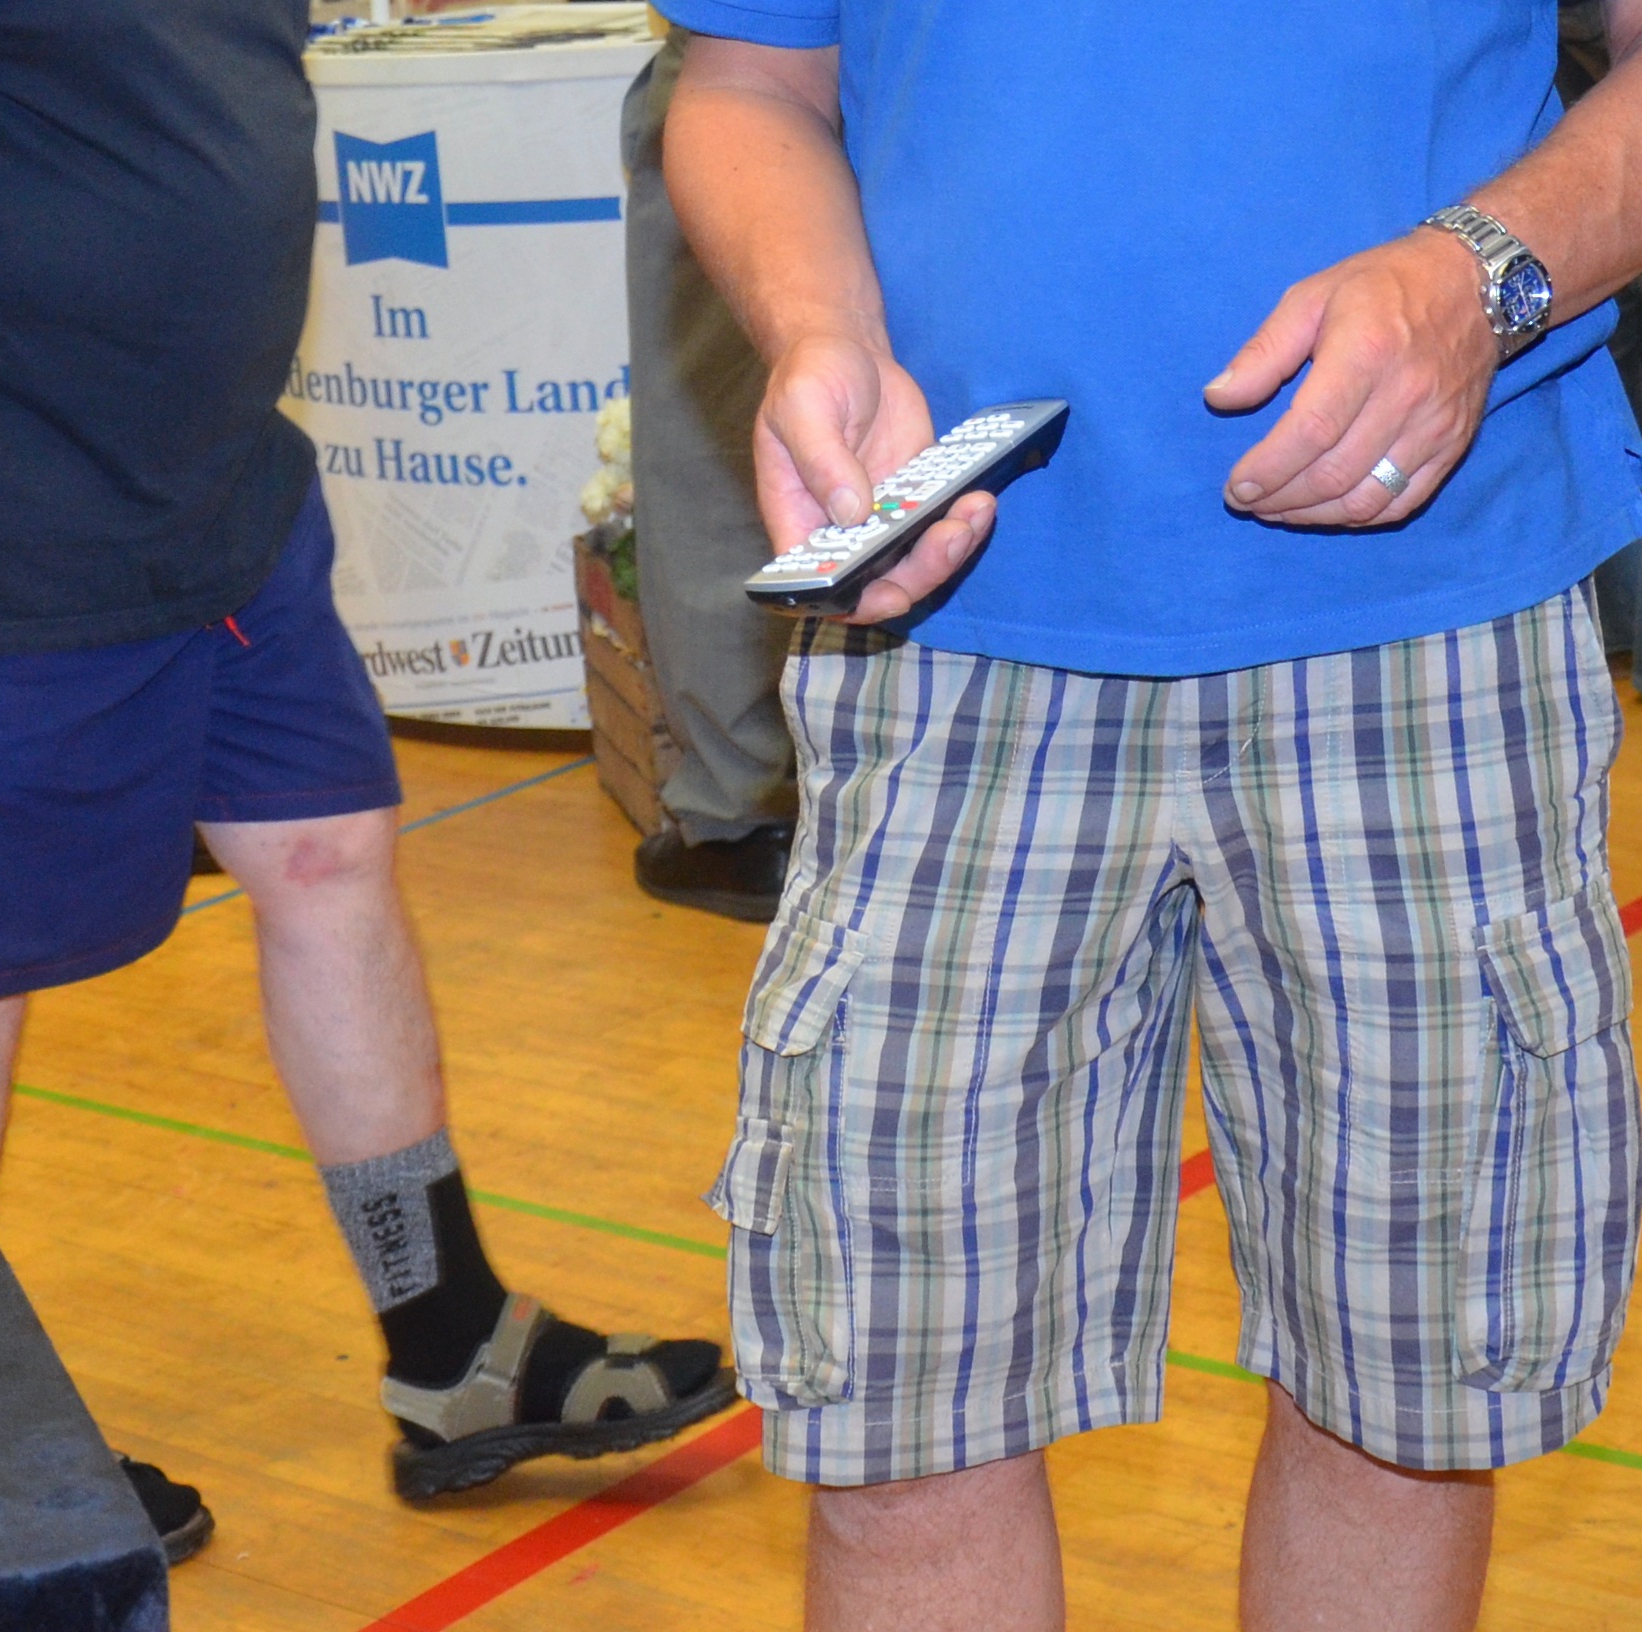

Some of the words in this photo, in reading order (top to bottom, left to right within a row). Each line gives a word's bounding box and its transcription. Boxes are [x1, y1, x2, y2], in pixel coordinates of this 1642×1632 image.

[346, 160, 430, 205] NWZ
[371, 295, 430, 340] Im
[325, 444, 367, 477] zu
[375, 437, 529, 488] Hause.
[362, 1190, 420, 1300] FITNESS
